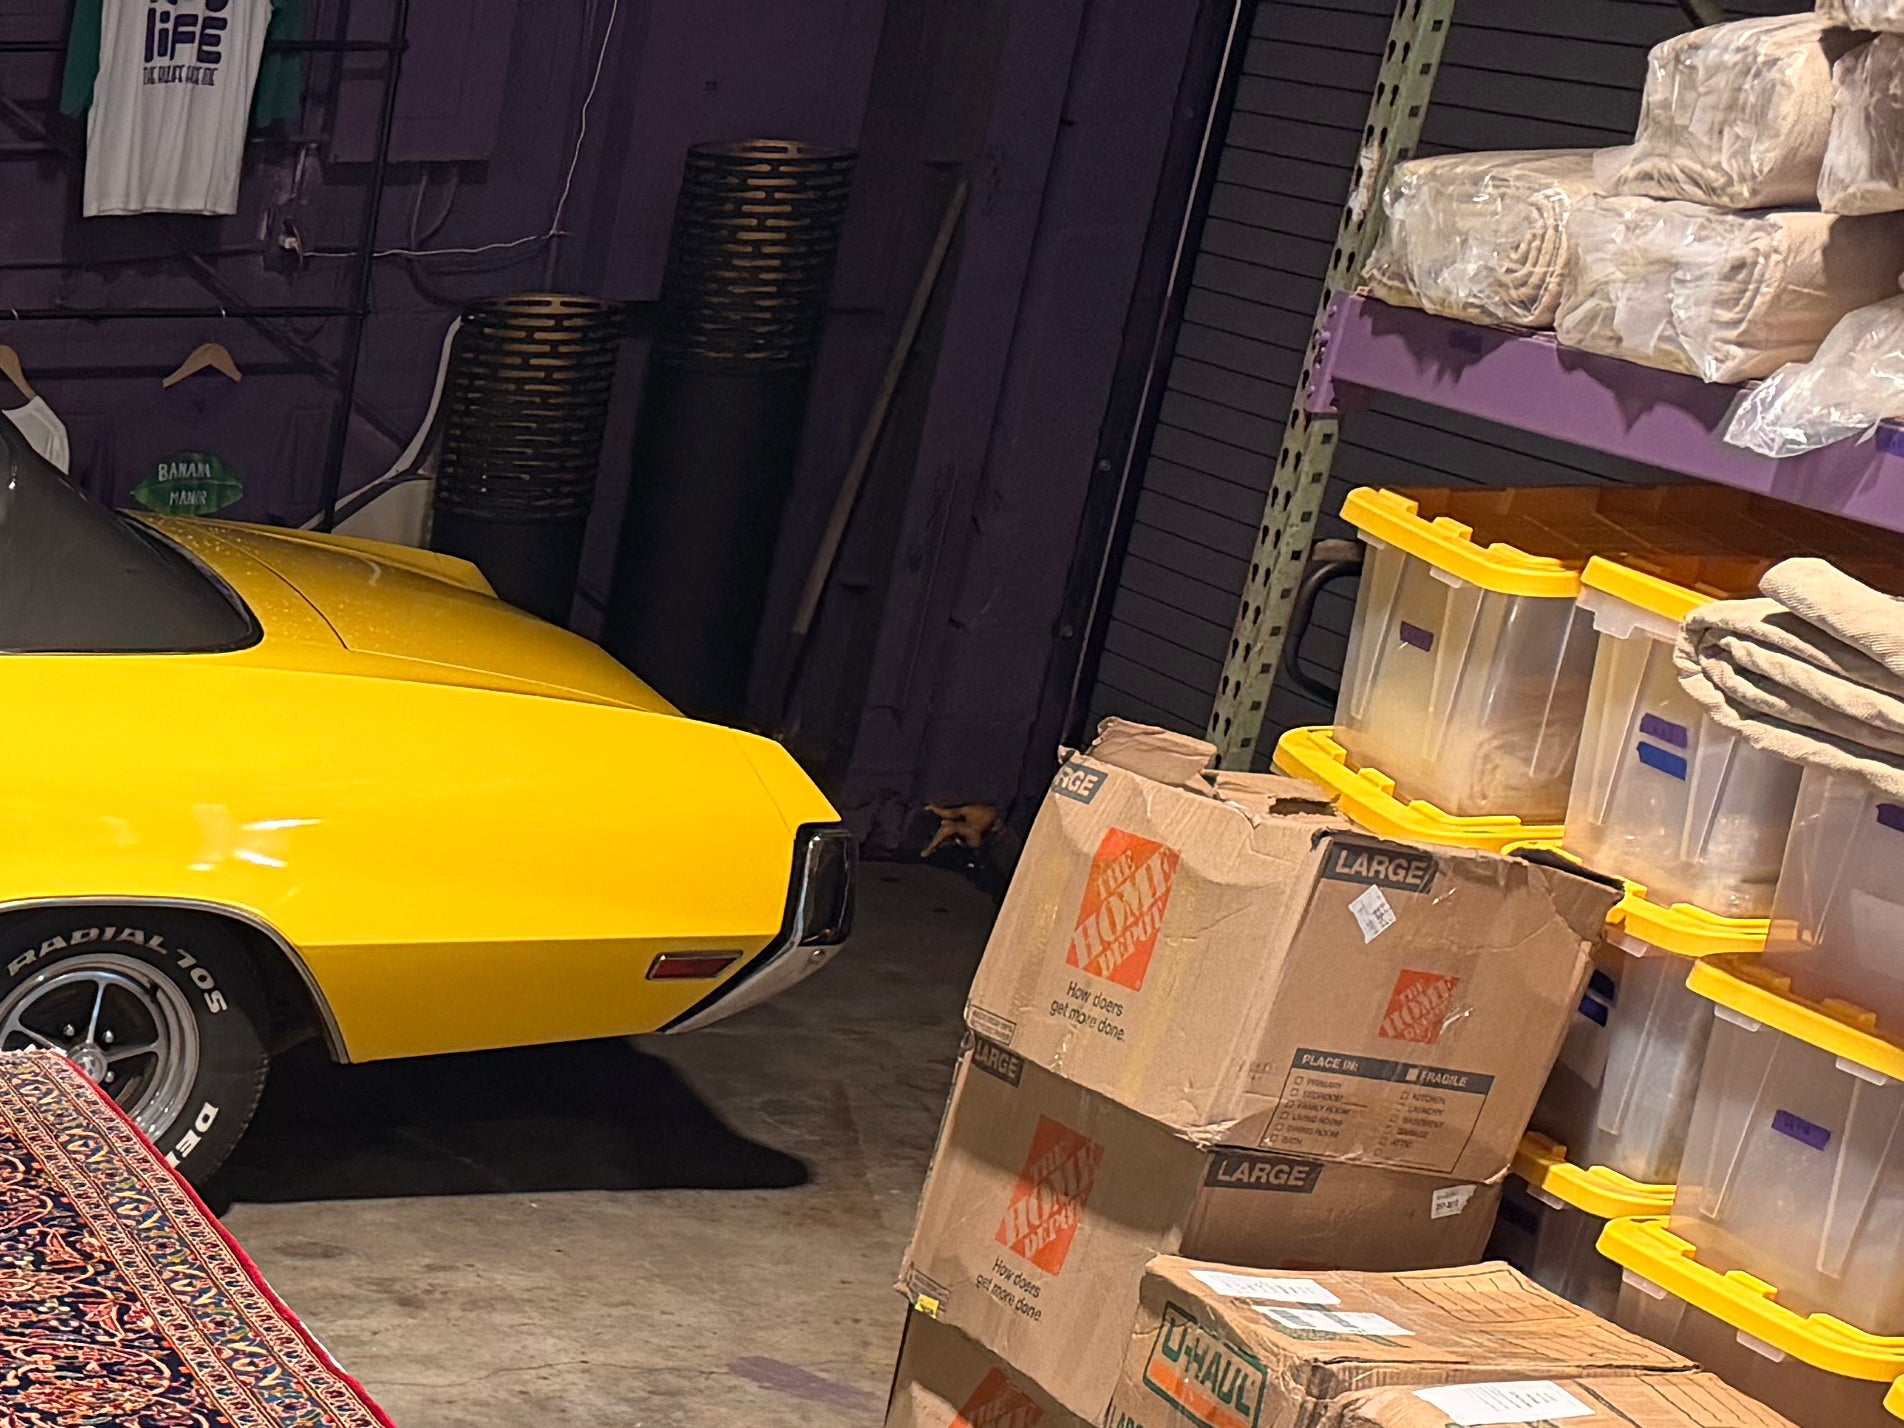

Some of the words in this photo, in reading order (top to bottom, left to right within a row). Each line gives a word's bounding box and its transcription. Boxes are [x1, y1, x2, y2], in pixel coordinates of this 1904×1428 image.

[1335, 851, 1429, 885] LARGE
[6, 926, 169, 978] RADIAL
[1049, 998, 1070, 1018] get
[1066, 980, 1092, 1004] How
[1092, 992, 1124, 1017] doers
[1301, 1053, 1342, 1070] PLACE
[1420, 1070, 1468, 1088] FRAGILE
[1217, 1160, 1310, 1187] LARGE
[975, 1272, 992, 1291] get
[992, 1257, 1015, 1283] How
[1161, 1316, 1252, 1418] U-HAUL
